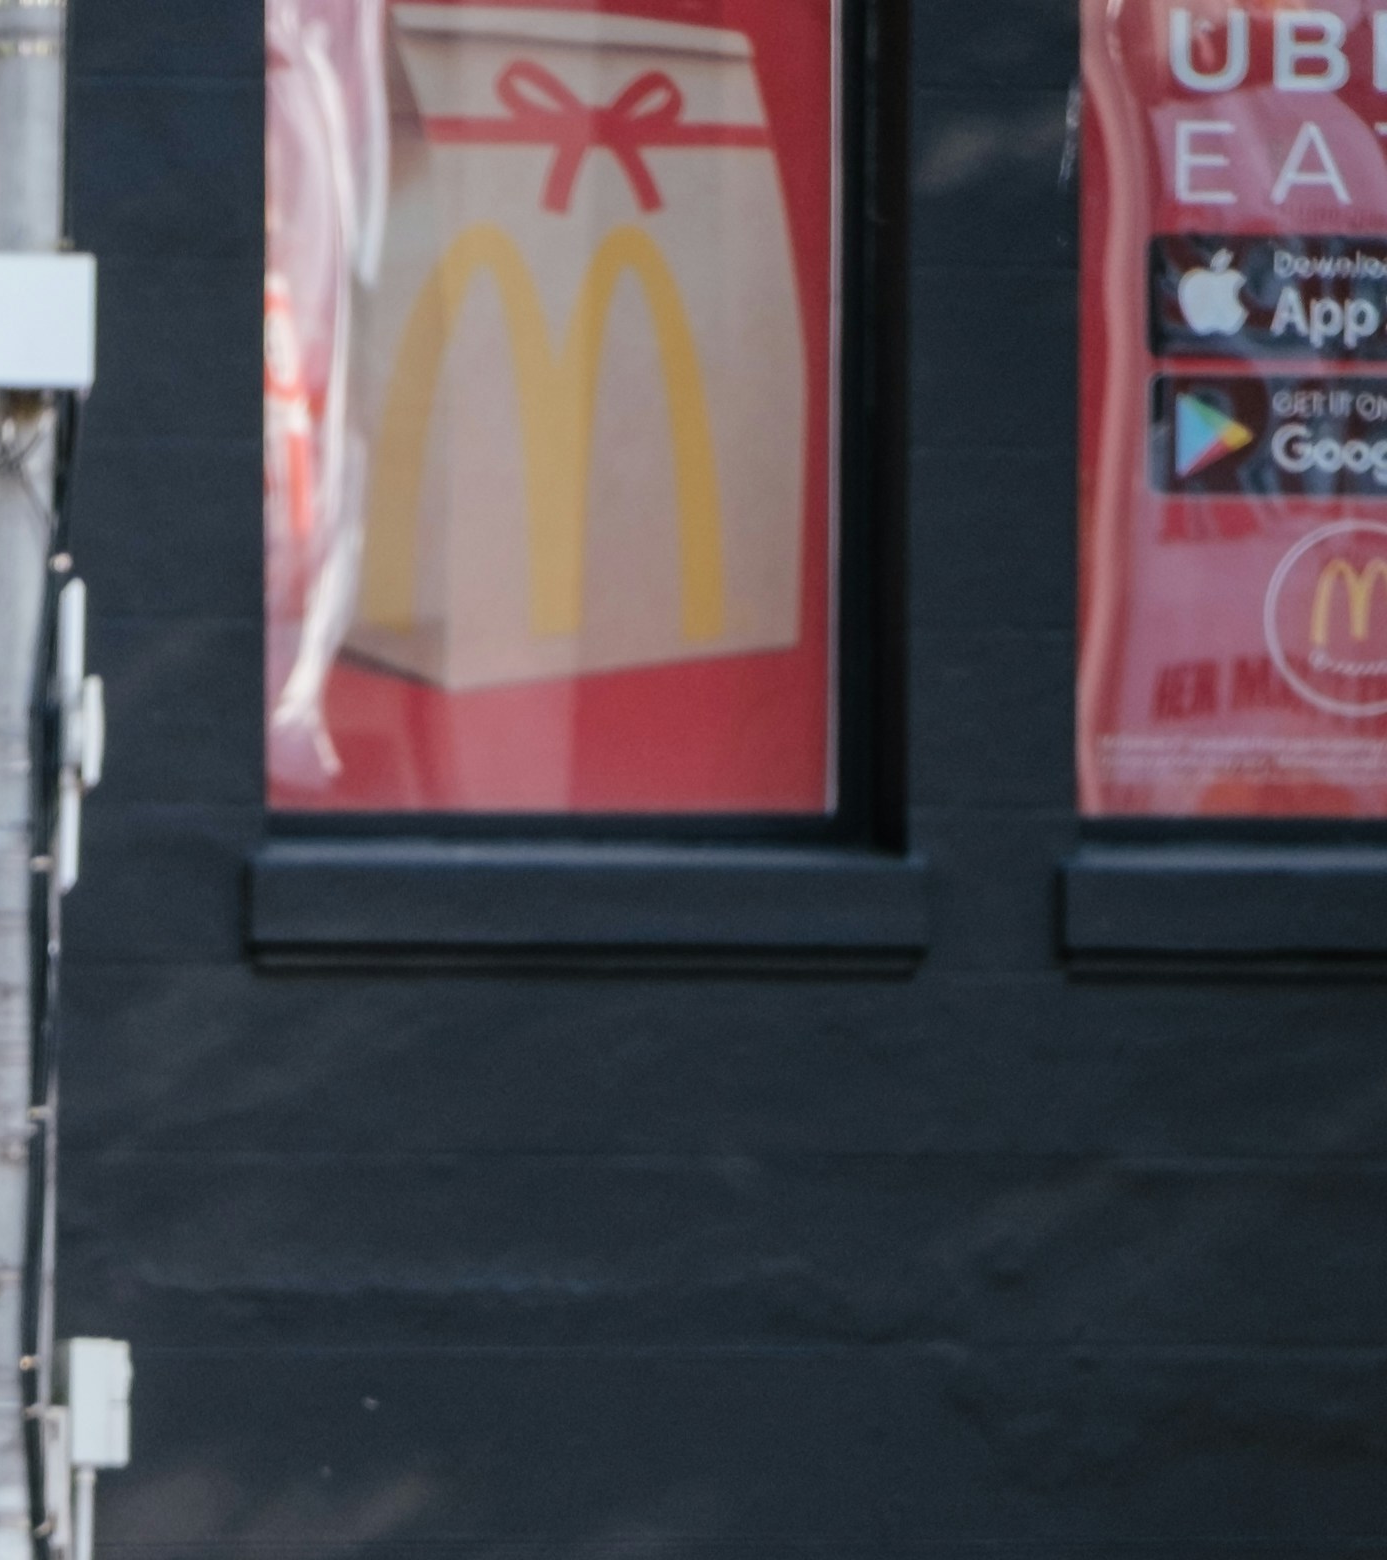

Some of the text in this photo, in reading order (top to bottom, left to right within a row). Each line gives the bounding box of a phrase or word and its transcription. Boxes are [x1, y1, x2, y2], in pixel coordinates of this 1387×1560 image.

[1169, 6, 1387, 93] UB
[1175, 121, 1387, 205] EA
[1270, 285, 1380, 349] App
